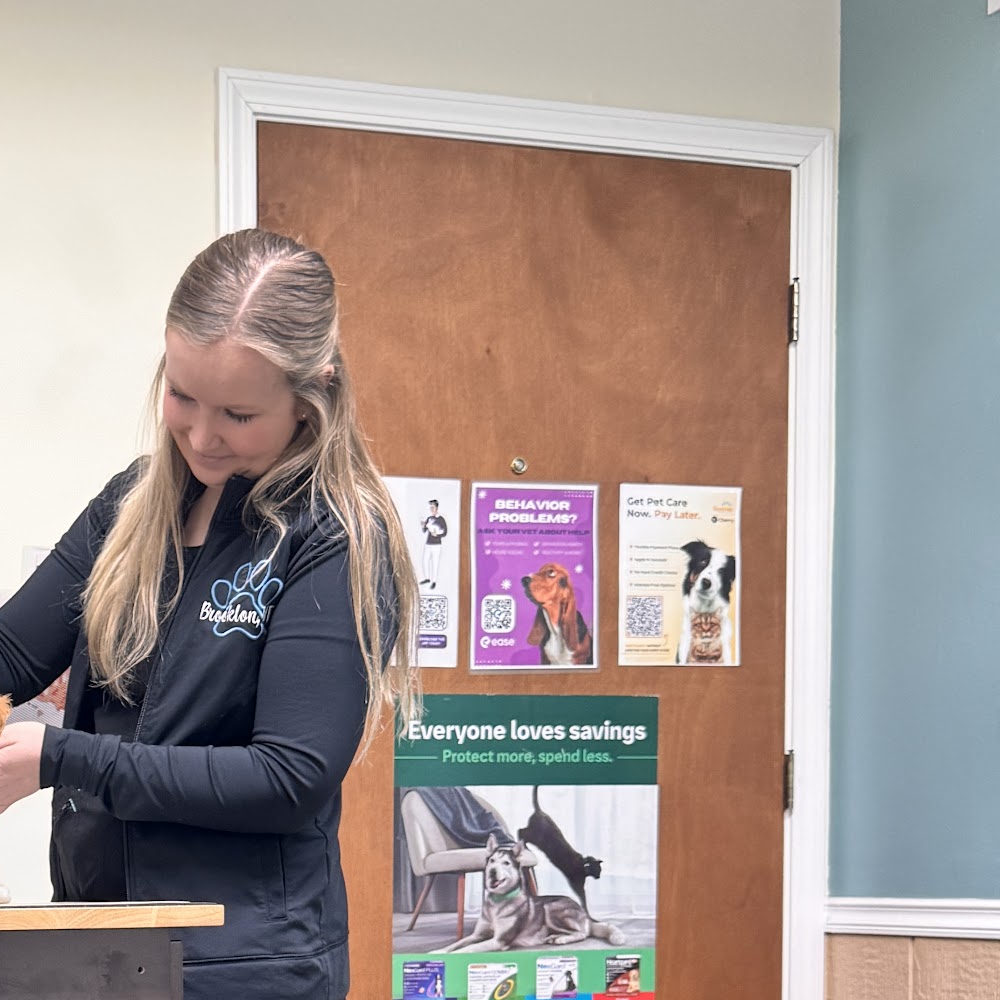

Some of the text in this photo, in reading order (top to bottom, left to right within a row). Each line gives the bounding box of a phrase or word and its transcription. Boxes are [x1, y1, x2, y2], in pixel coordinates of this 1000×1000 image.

[494, 499, 571, 511] BEHAVIOR
[626, 497, 688, 507] Get Pet Care
[488, 512, 578, 524] PROBLEMS?
[626, 509, 701, 520] Now. Pay Later.
[491, 638, 515, 647] ease
[408, 719, 647, 745] Everyone loves savings
[442, 749, 613, 765] Protect more, spend less.
